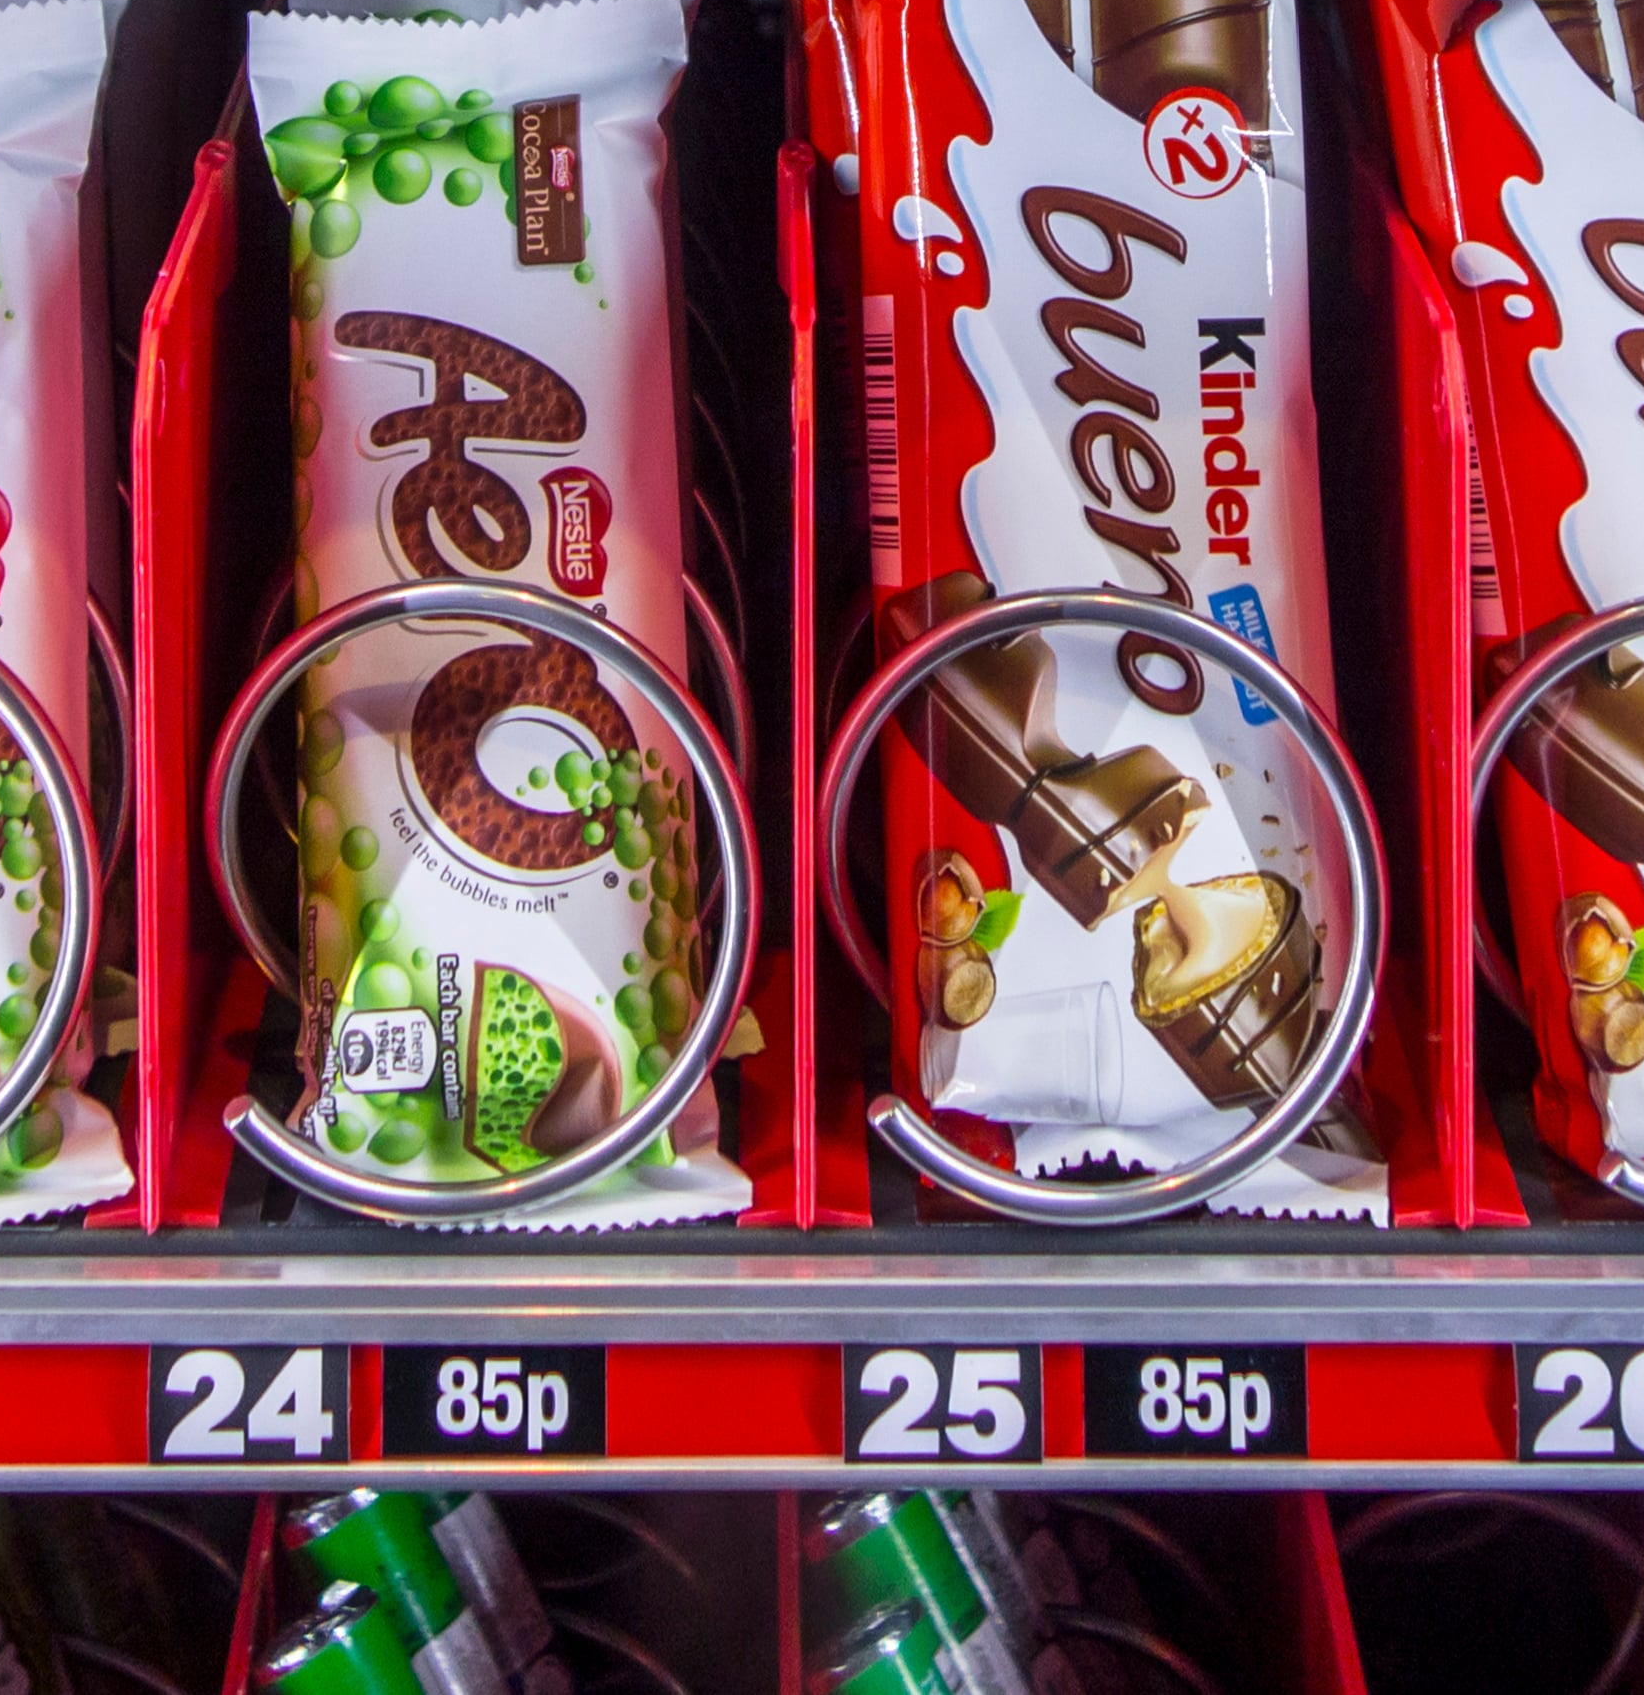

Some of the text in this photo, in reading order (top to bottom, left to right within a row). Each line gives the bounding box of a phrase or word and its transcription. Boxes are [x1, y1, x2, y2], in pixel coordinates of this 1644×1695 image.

[524, 186, 552, 254] Plan
[1021, 185, 1206, 716] bueno
[1197, 316, 1267, 567] Kinder
[562, 479, 594, 582] Nestlé
[388, 807, 509, 912] feel the bubbles
[435, 953, 461, 1005] Each
[373, 1019, 392, 1081] 199kcal
[389, 1025, 407, 1072] 829kJ
[405, 1019, 429, 1076] Energy
[439, 1005, 463, 1046] bar
[165, 1350, 333, 1455] 24
[437, 1361, 568, 1449] 85p
[860, 1351, 1025, 1454] 25
[1140, 1360, 1270, 1448] 85p
